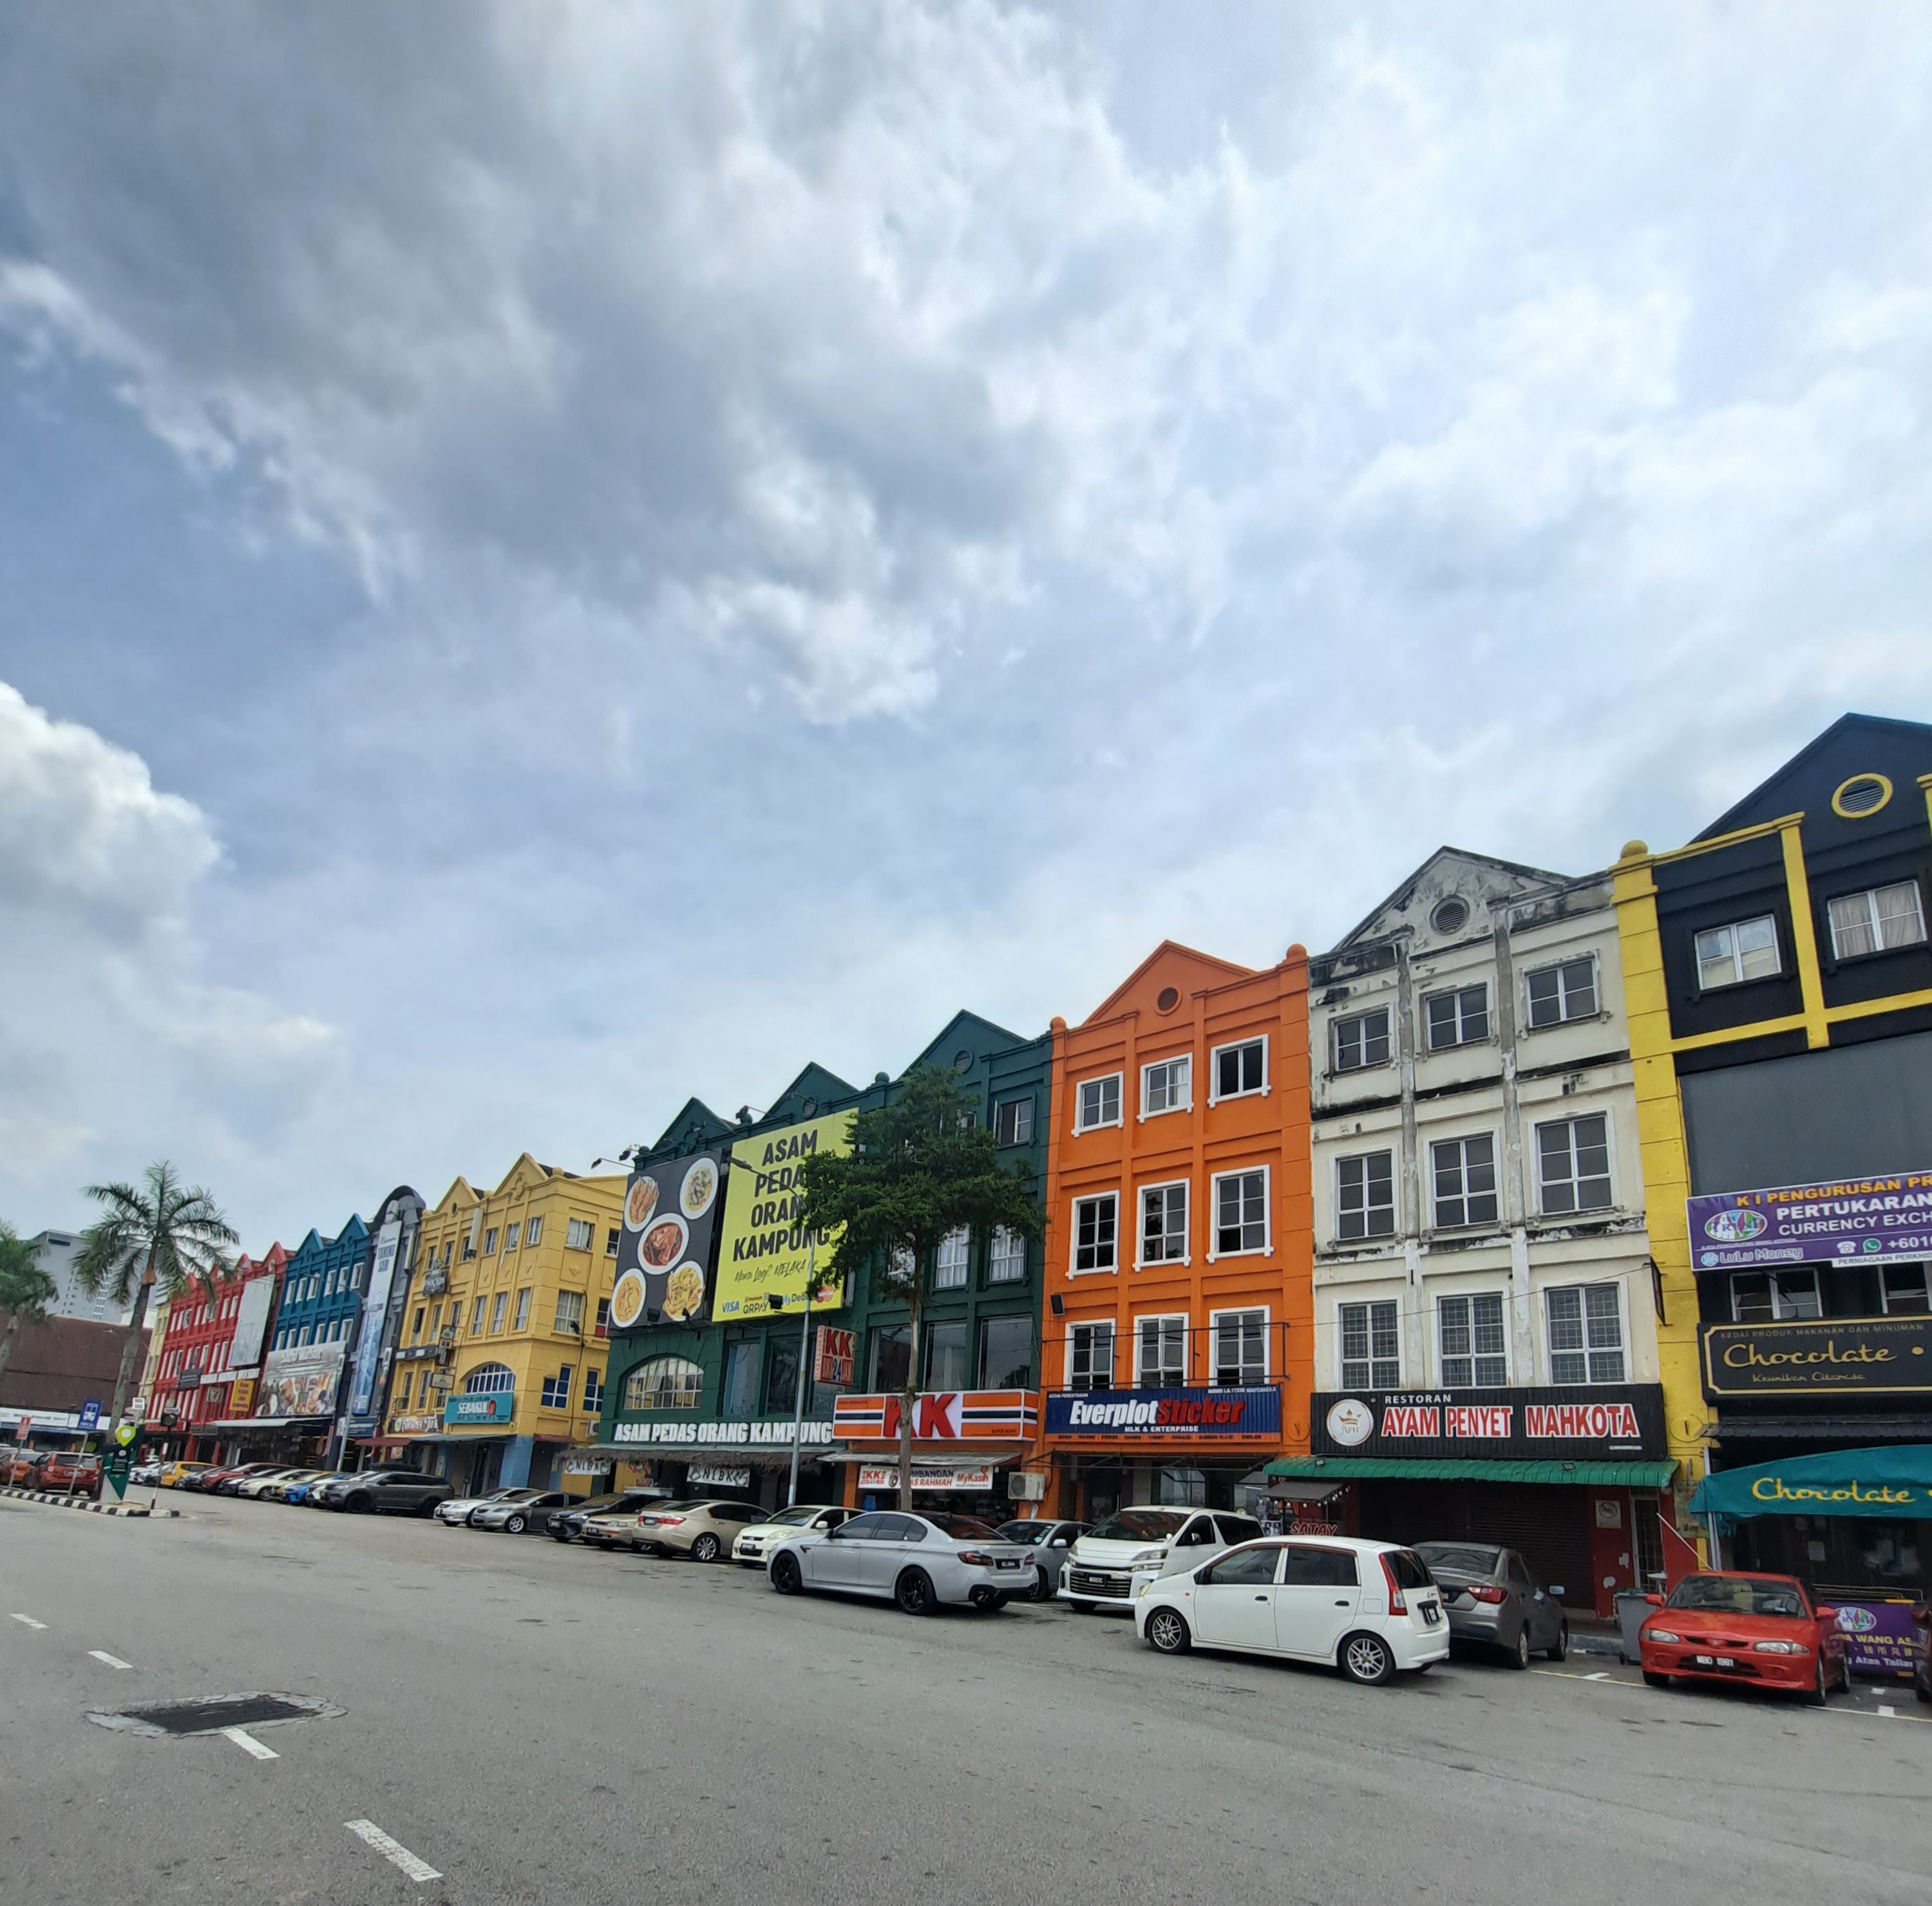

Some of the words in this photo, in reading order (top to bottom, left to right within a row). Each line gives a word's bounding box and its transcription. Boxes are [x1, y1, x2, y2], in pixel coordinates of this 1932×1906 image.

[762, 1129, 818, 1166] ASAM
[755, 1164, 804, 1198] PEDA
[1736, 1196, 1749, 1207] K
[1756, 1195, 1761, 1205] I
[1767, 1179, 1901, 1204] PENGURUSAN
[751, 1194, 804, 1228] ORAN
[1777, 1193, 1932, 1221] PERTUKARAN
[1778, 1214, 1878, 1236] CURRENCY
[1883, 1211, 1932, 1227] EXCH
[1755, 1247, 1803, 1261] Money
[1887, 1237, 1932, 1249] +601
[774, 1259, 806, 1278] MELAKA
[1838, 1255, 1893, 1265] PERNIAGAAN
[722, 1301, 740, 1313] VISA
[1752, 1329, 1792, 1337] PRODUK
[1795, 1327, 1844, 1336] MAKANAN
[1848, 1326, 1870, 1334] DAN
[1873, 1324, 1924, 1333] MINUMAN
[825, 1329, 853, 1358] KK
[1723, 1340, 1897, 1368] Chocolate
[832, 1358, 841, 1382] 24
[1385, 1394, 1452, 1404] RESTORAN
[882, 1393, 957, 1438] KK
[1381, 1406, 1440, 1437] AYAM
[1446, 1406, 1513, 1438] PENYET
[1525, 1403, 1641, 1438] MAHKOTA
[614, 1423, 651, 1442] ASAM
[651, 1422, 697, 1442] PEDAS
[697, 1422, 748, 1443] ORANG
[749, 1422, 832, 1444] KAMPUNG
[866, 1471, 882, 1479] KK
[956, 1473, 989, 1484] MyKasih
[1752, 1477, 1916, 1503] Chocolate
[1291, 1522, 1338, 1536] SATAY
[1855, 1634, 1893, 1645] WANG
[1855, 1656, 1880, 1665] Atas
